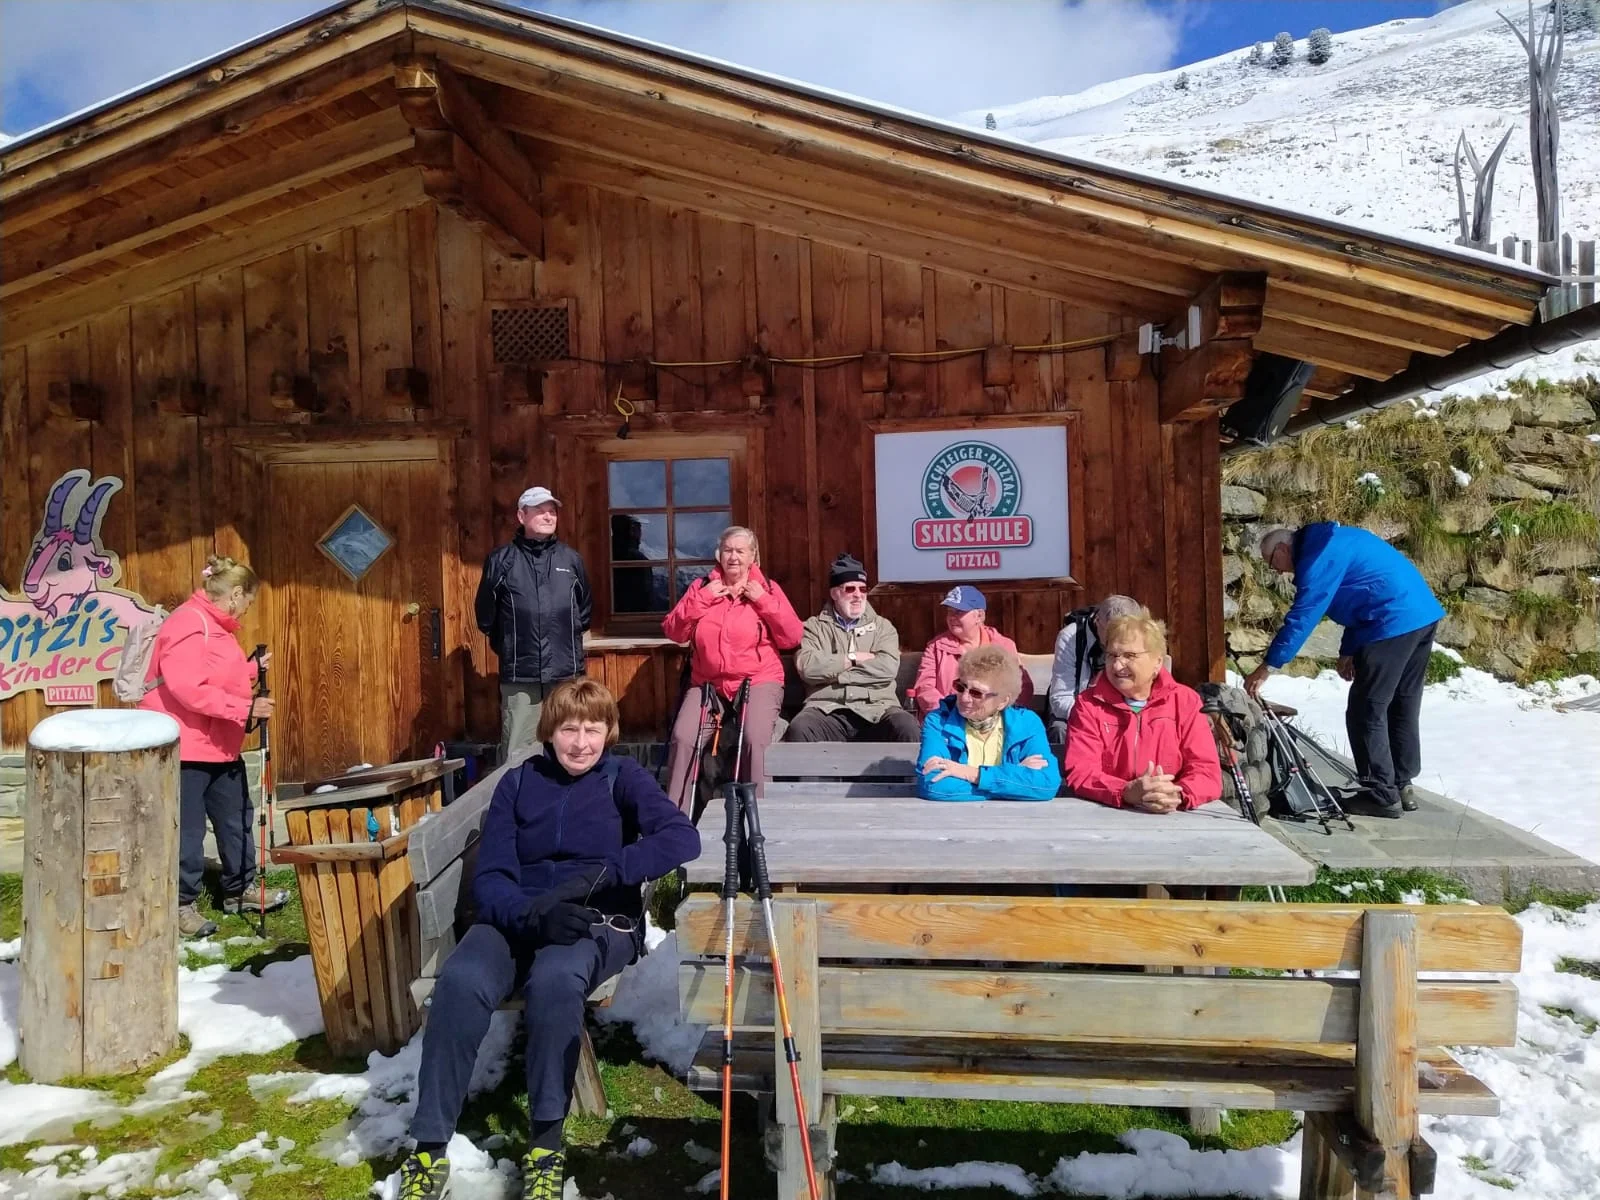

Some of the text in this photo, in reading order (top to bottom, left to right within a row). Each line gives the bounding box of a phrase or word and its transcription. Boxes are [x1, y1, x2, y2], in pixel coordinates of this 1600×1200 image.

[927, 447, 1016, 500] HOCHZEIGER PITZTAL
[921, 521, 1024, 544] SKISCHULE
[947, 552, 999, 568] PITZTAL
[48, 687, 94, 701] PITZTAL
